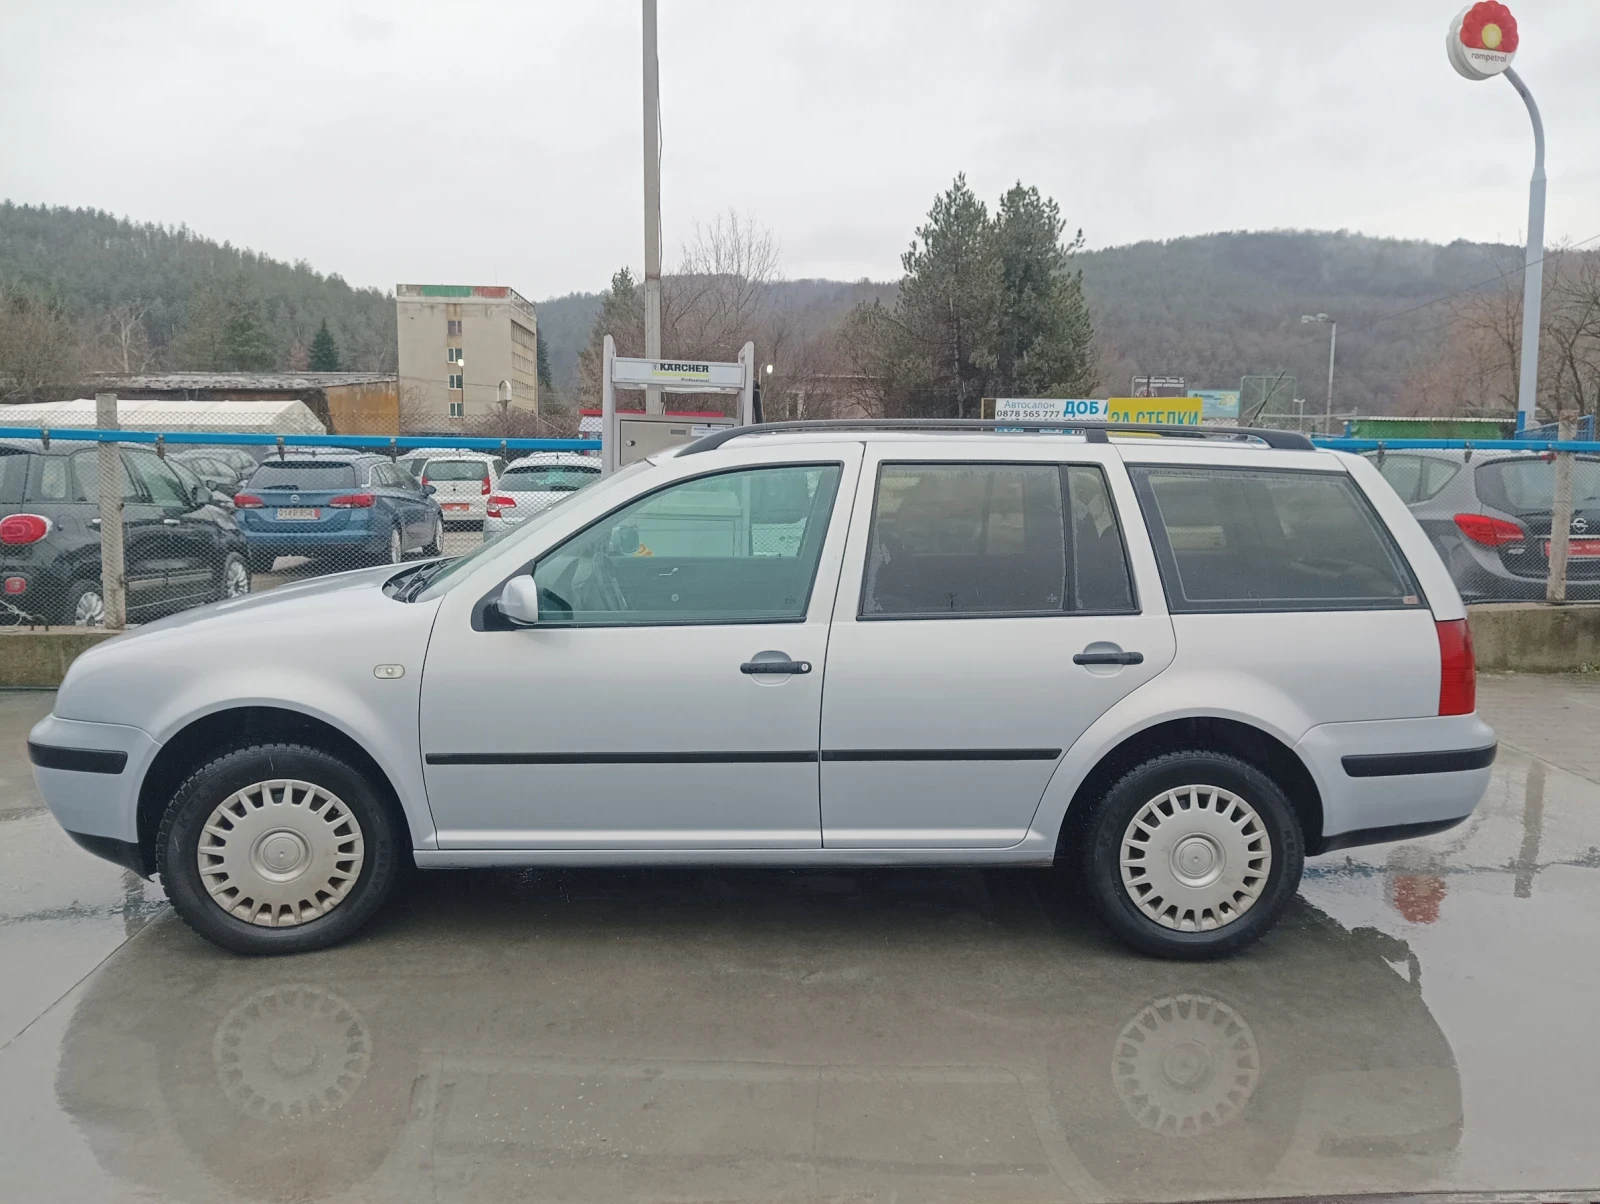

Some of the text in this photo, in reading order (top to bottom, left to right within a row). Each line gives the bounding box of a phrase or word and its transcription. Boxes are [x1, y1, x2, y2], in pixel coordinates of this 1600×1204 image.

[1471, 52, 1507, 63] rompetrol
[1004, 400, 1055, 410] Автосалон
[1063, 400, 1098, 418] ДОБ
[996, 410, 1060, 418] 0878 565 777
